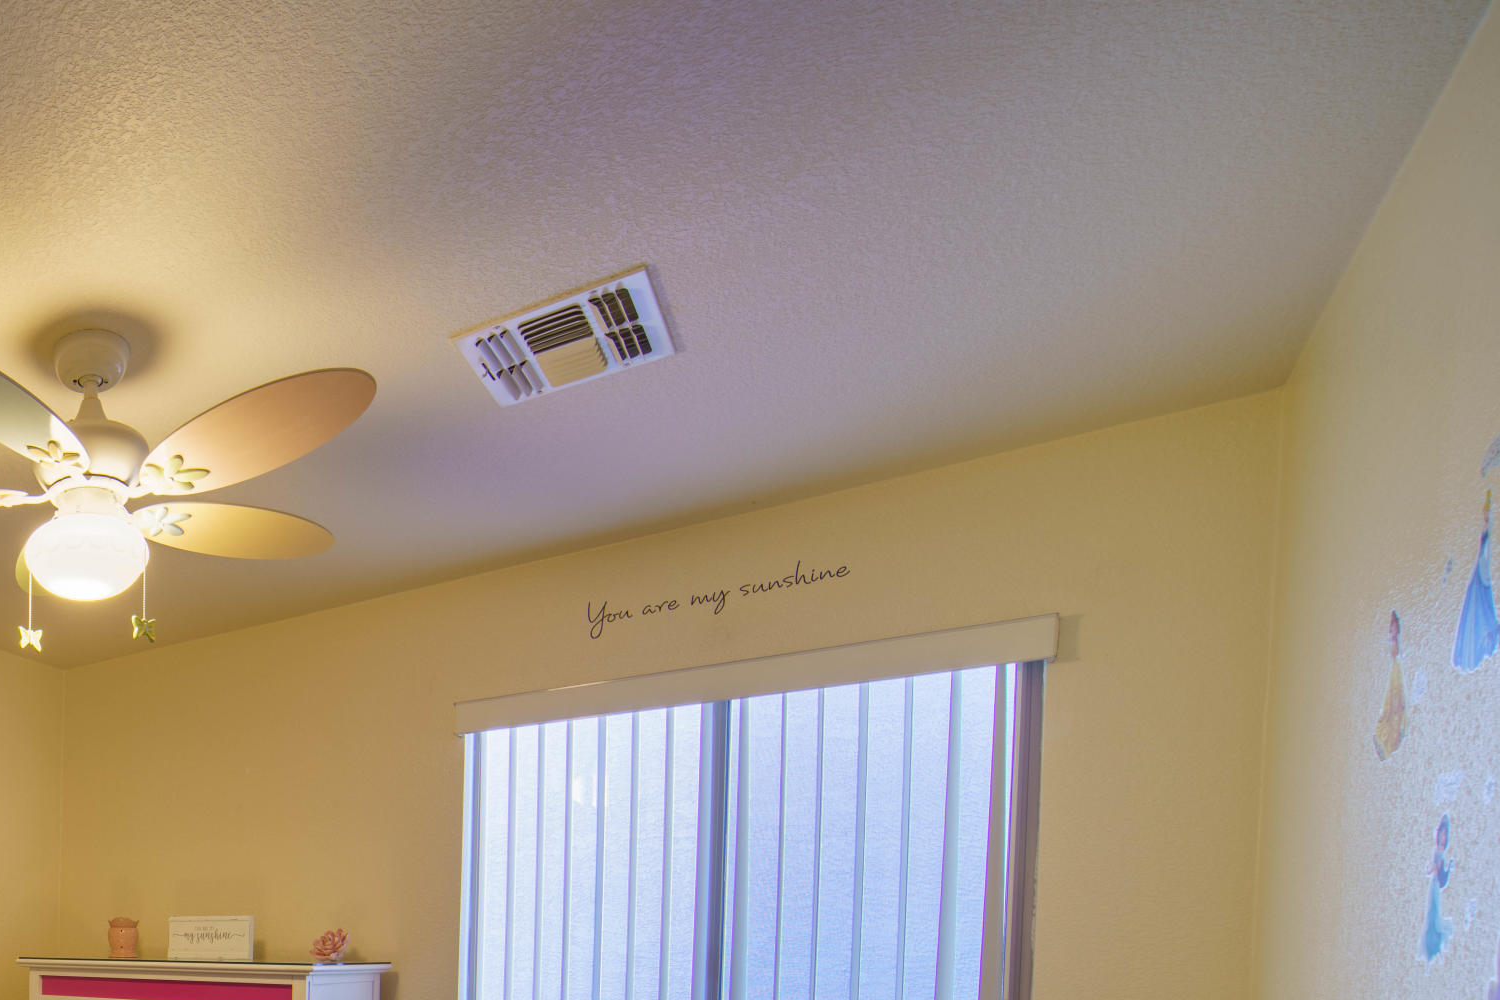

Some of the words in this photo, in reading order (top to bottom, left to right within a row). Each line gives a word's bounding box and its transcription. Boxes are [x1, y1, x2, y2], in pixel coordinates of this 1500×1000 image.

[587, 600, 633, 640] You
[642, 599, 680, 616] are
[690, 588, 731, 615] my
[739, 560, 851, 597] sunshine
